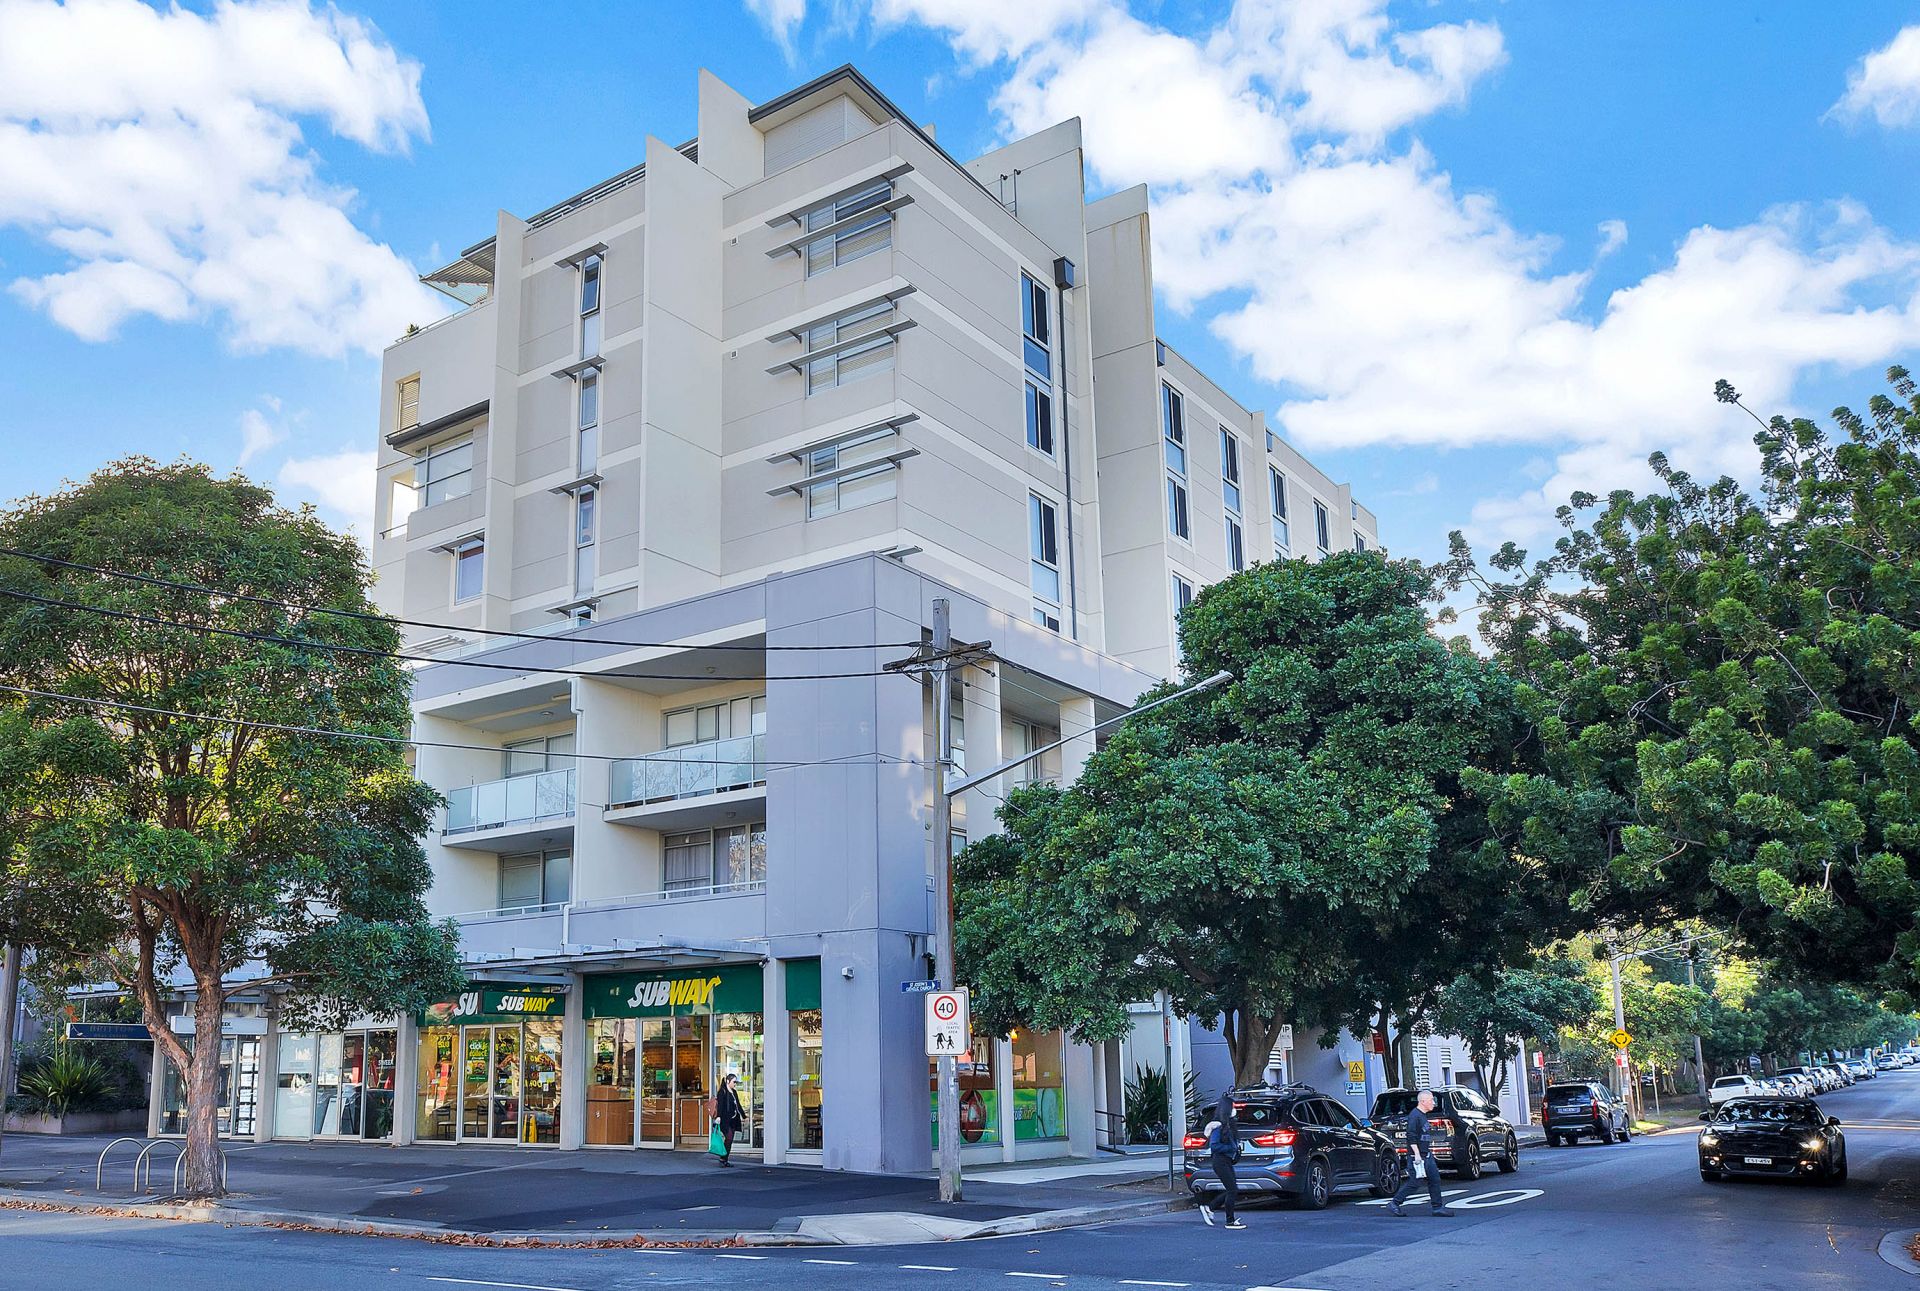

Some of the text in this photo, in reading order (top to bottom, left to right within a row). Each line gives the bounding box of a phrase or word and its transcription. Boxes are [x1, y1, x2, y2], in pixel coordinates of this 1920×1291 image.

[627, 975, 722, 1008] SUBWAY
[496, 994, 555, 1012] SUBWAY
[938, 1002, 954, 1013] 40
